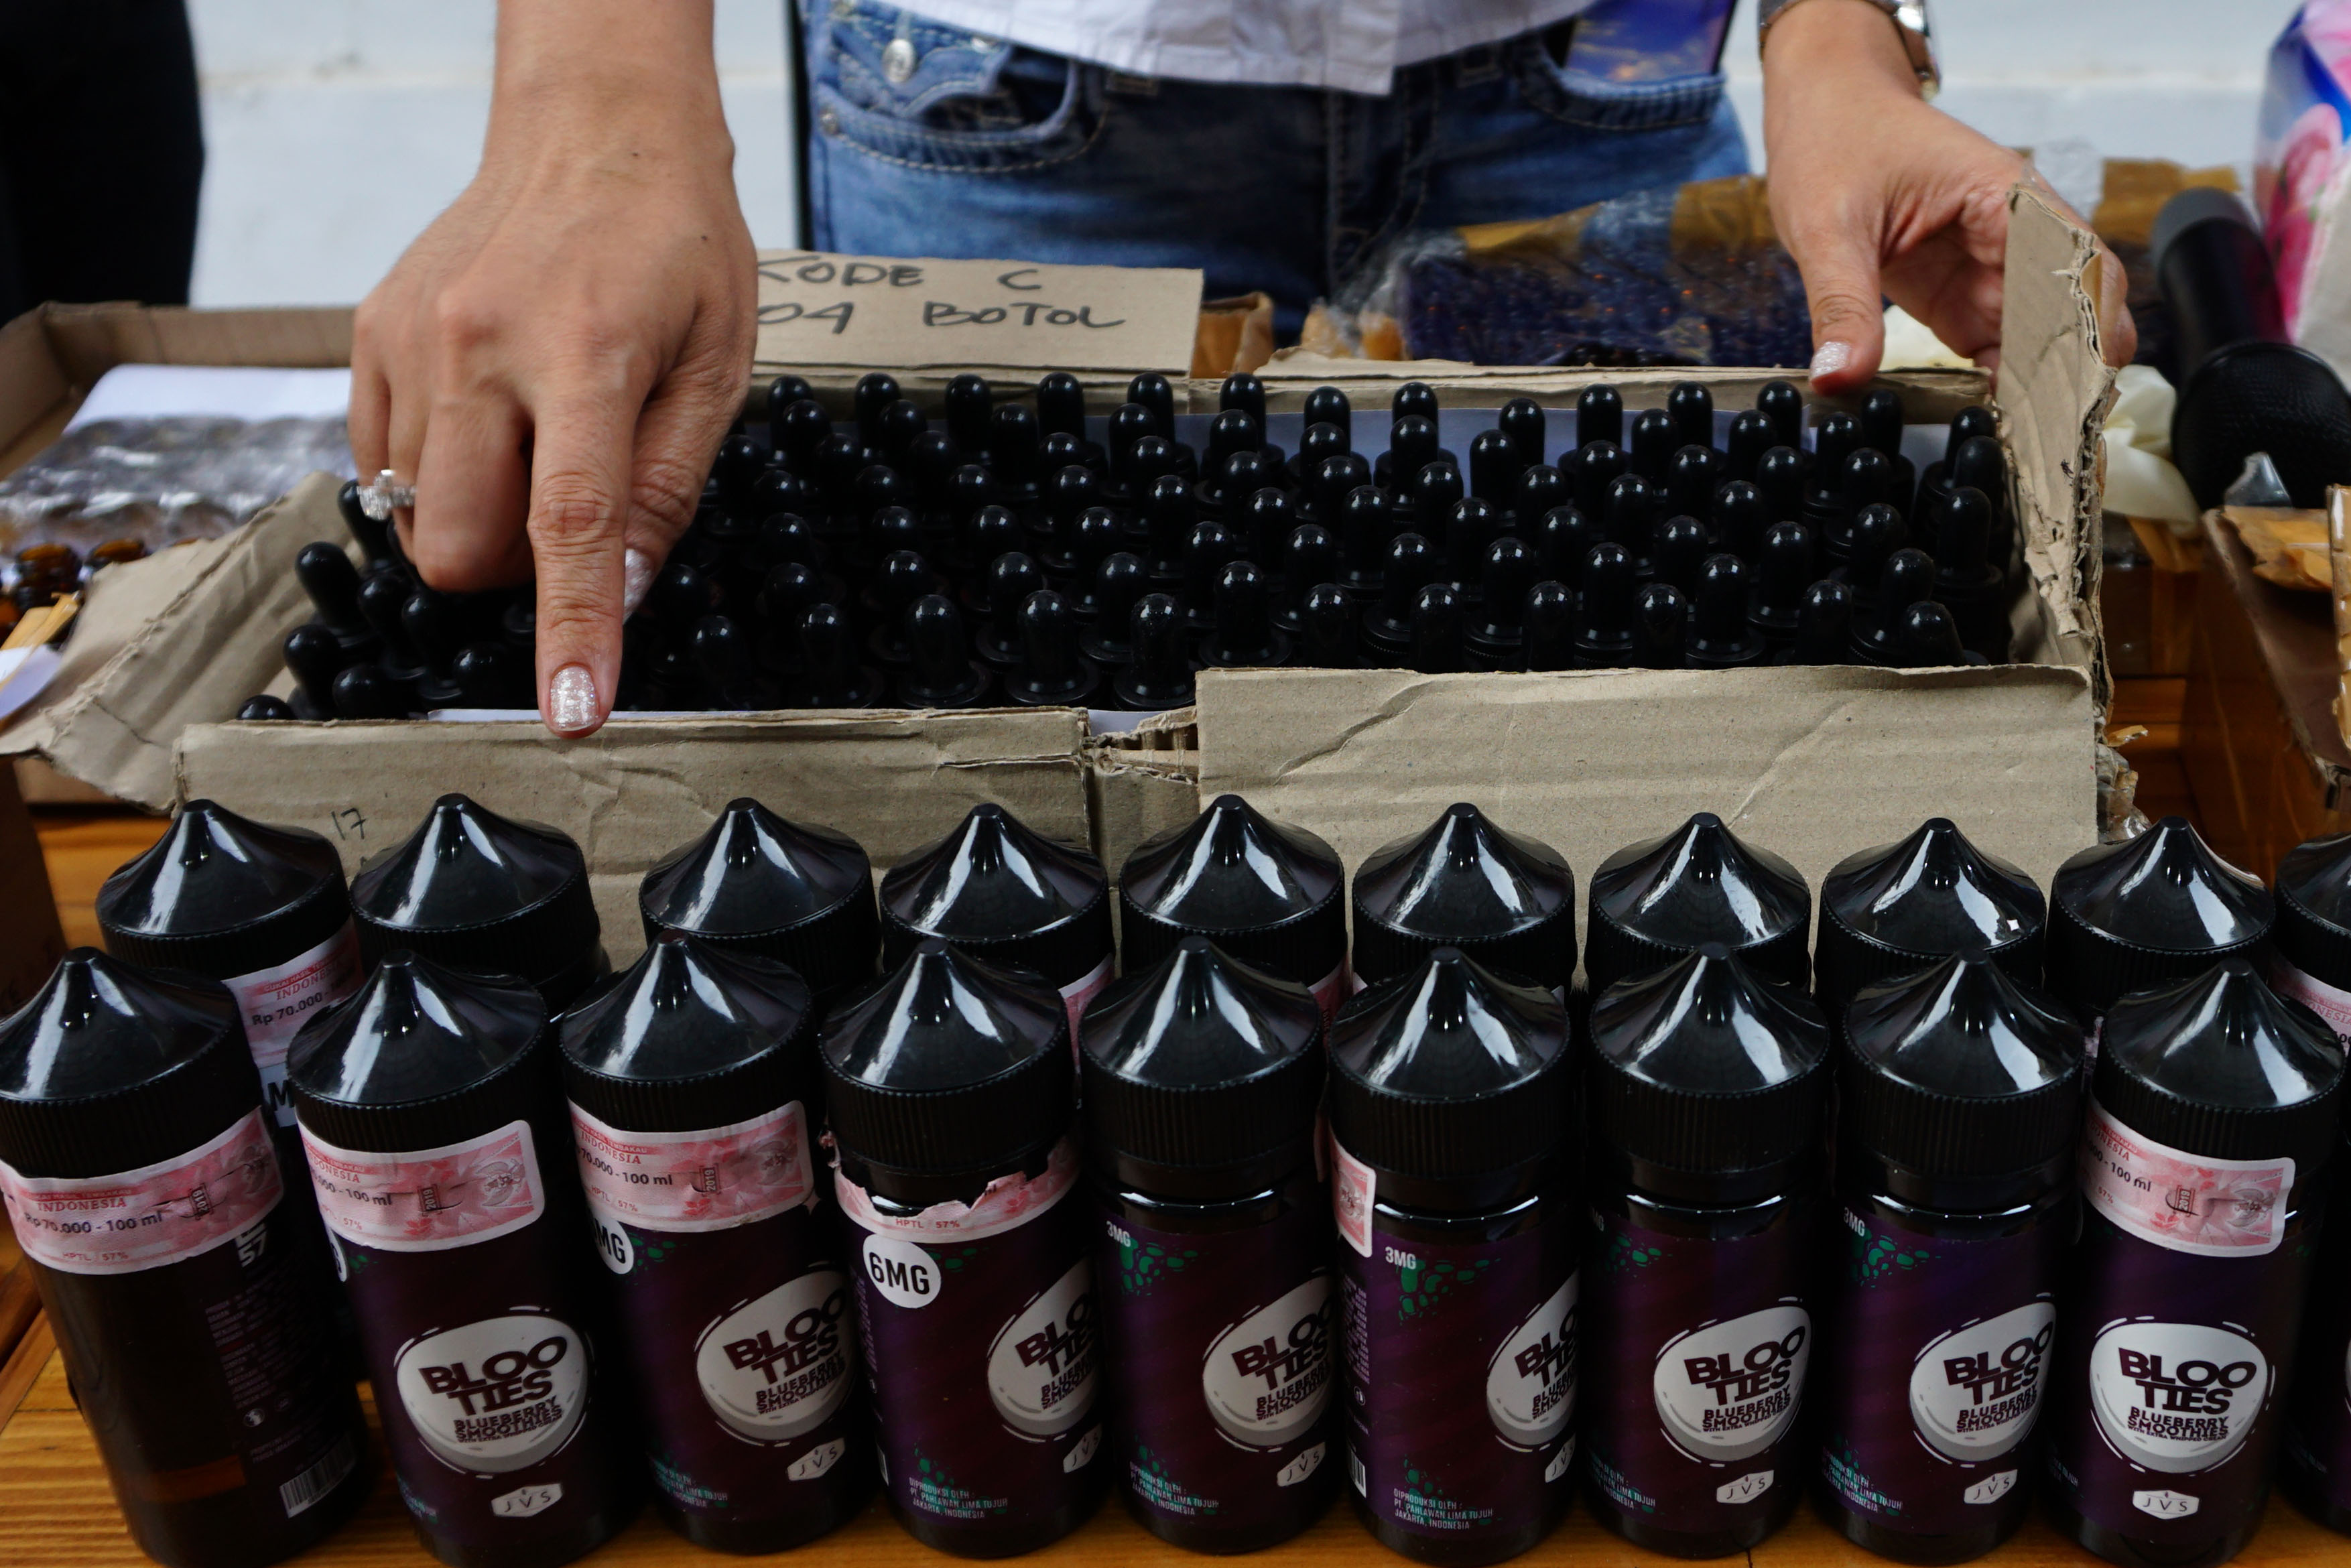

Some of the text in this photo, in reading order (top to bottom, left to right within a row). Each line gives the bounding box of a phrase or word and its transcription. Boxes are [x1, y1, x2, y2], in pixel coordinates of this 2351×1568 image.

[998, 269, 1042, 289] C
[922, 302, 1127, 328] BOTOL
[331, 807, 367, 841] 17
[252, 1010, 274, 1026] Rp
[276, 992, 322, 1020] 70.000
[580, 1130, 641, 1165] INDONESIA
[622, 1172, 649, 1185] 100
[653, 1173, 674, 1185] ml
[704, 1169, 716, 1191] 2019
[2111, 1162, 2131, 1183] 100
[2134, 1178, 2152, 1192] ml
[38, 1197, 127, 1213] INDONESIA
[346, 1189, 370, 1202] 100
[372, 1193, 392, 1205] ml
[422, 1189, 435, 1210] 2019
[617, 1199, 638, 1212] 57%
[2178, 1189, 2191, 1212] 2019
[42, 1218, 92, 1234] 70.000
[106, 1218, 137, 1232] 100
[141, 1210, 163, 1226] ml
[343, 1218, 363, 1231] 57%
[895, 1218, 960, 1229] HPTL 57%
[1843, 1205, 1865, 1237] 3MG
[595, 1226, 627, 1264] MG
[1106, 1220, 1132, 1248] 3MG
[101, 1252, 129, 1261] 57%
[1385, 1246, 1417, 1270] 3MG
[869, 1252, 930, 1295] 6MG
[722, 1287, 846, 1370] BLOO
[1015, 1293, 1095, 1368] BLO
[1038, 1321, 1094, 1377] TIE
[1514, 1305, 1578, 1378] BLO
[1944, 1321, 2054, 1386] BLOO
[418, 1335, 568, 1395] BLOO
[750, 1323, 838, 1385] TIES
[1533, 1337, 1578, 1388] TIE
[1683, 1325, 1806, 1385] BLOO
[2118, 1347, 2257, 1389] BLOO
[1705, 1359, 1793, 1406] TIES
[1962, 1356, 2041, 1406] TIES
[446, 1370, 553, 1417] TIES
[1704, 1384, 1791, 1421] BLUEBERRY
[1959, 1380, 2037, 1419] BLUEBERRY
[2135, 1378, 2234, 1415] TIES
[453, 1395, 558, 1430] BLUEBERRY
[455, 1405, 562, 1439] SMOOTHIES
[1702, 1392, 1791, 1429] SMOOTHIES
[2130, 1405, 2229, 1430] BLUEBERRY
[2127, 1415, 2229, 1438] SMOOTHIES
[2147, 1430, 2168, 1439] EXTRA
[909, 1476, 949, 1498] DIPRODUKSI
[950, 1490, 970, 1500] OLEH
[1164, 1481, 1182, 1494] OLEH
[1726, 1477, 1767, 1500] JVS
[1853, 1473, 1869, 1488] OLEH
[1973, 1478, 2010, 1500] JVS
[921, 1492, 960, 1508] PAHLAWAN
[962, 1500, 981, 1509] LIMA
[983, 1497, 1009, 1508] TUJUH
[1158, 1499, 1196, 1516] INDONESIA
[1173, 1494, 1192, 1506] LIMA
[1194, 1498, 1220, 1508] TUJUH
[1393, 1488, 1436, 1508] DIPRODUKSI
[1438, 1500, 1457, 1510] OLEH
[1405, 1502, 1446, 1519] PAHLAWAN
[1447, 1511, 1466, 1520] LIMA
[1468, 1507, 1494, 1520] TUJUH
[1634, 1492, 1656, 1507] TUJUH
[1860, 1488, 1877, 1503] LIMA
[1879, 1495, 1903, 1511] TUJUH
[2142, 1496, 2188, 1512] JVS
[944, 1508, 986, 1519] INDONESIA
[1394, 1508, 1470, 1530] JAKARTA, INDONESIA
